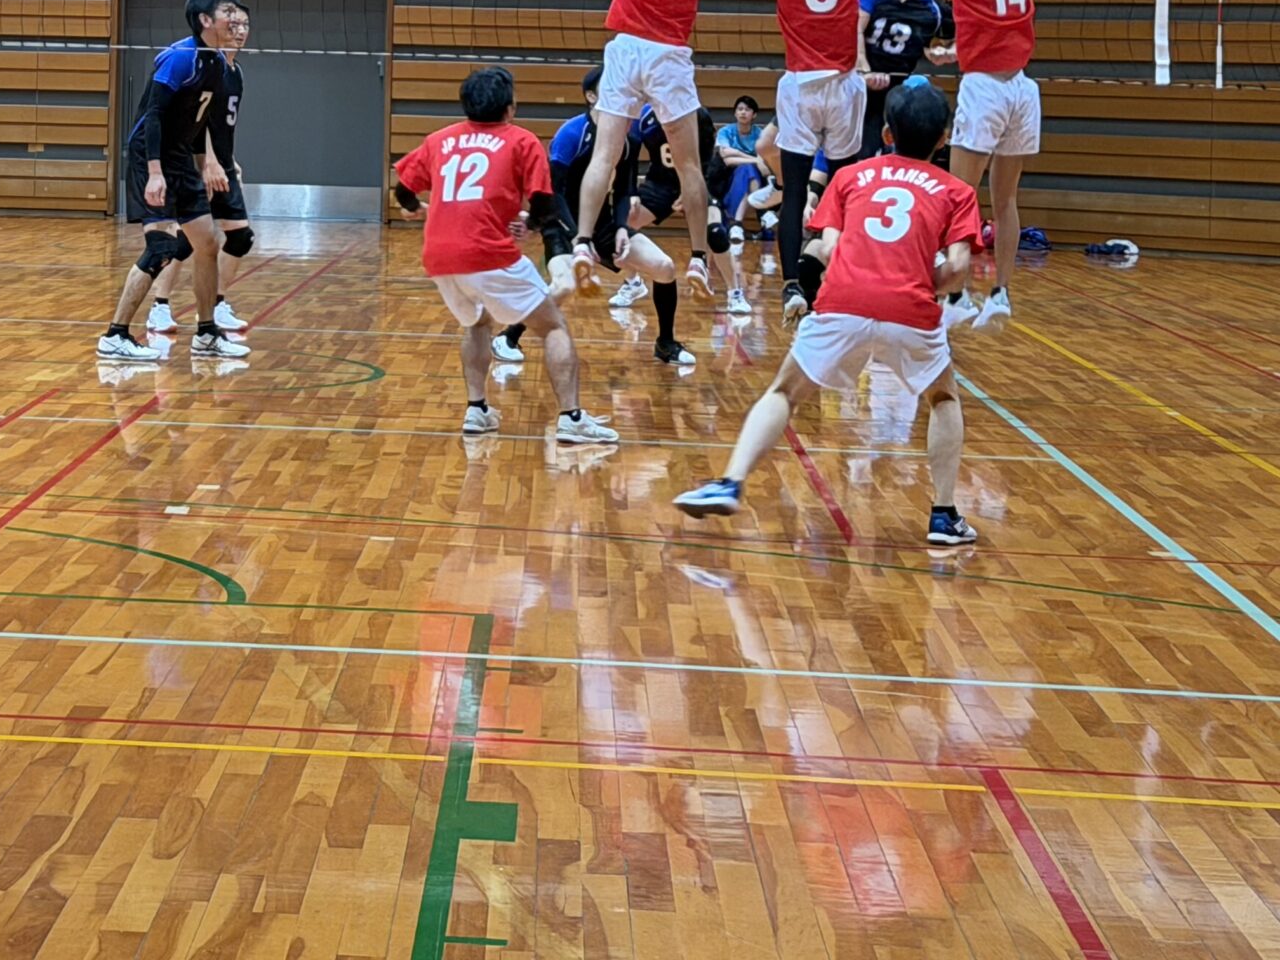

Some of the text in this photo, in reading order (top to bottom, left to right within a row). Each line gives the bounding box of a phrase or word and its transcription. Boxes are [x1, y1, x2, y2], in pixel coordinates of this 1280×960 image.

[866, 17, 913, 54] 13
[196, 91, 213, 122] 7
[226, 95, 239, 126] 5
[441, 132, 506, 154] JP KANSAI
[440, 152, 489, 202] 12
[857, 166, 946, 195] JP KANSAI
[864, 186, 915, 243] 3
